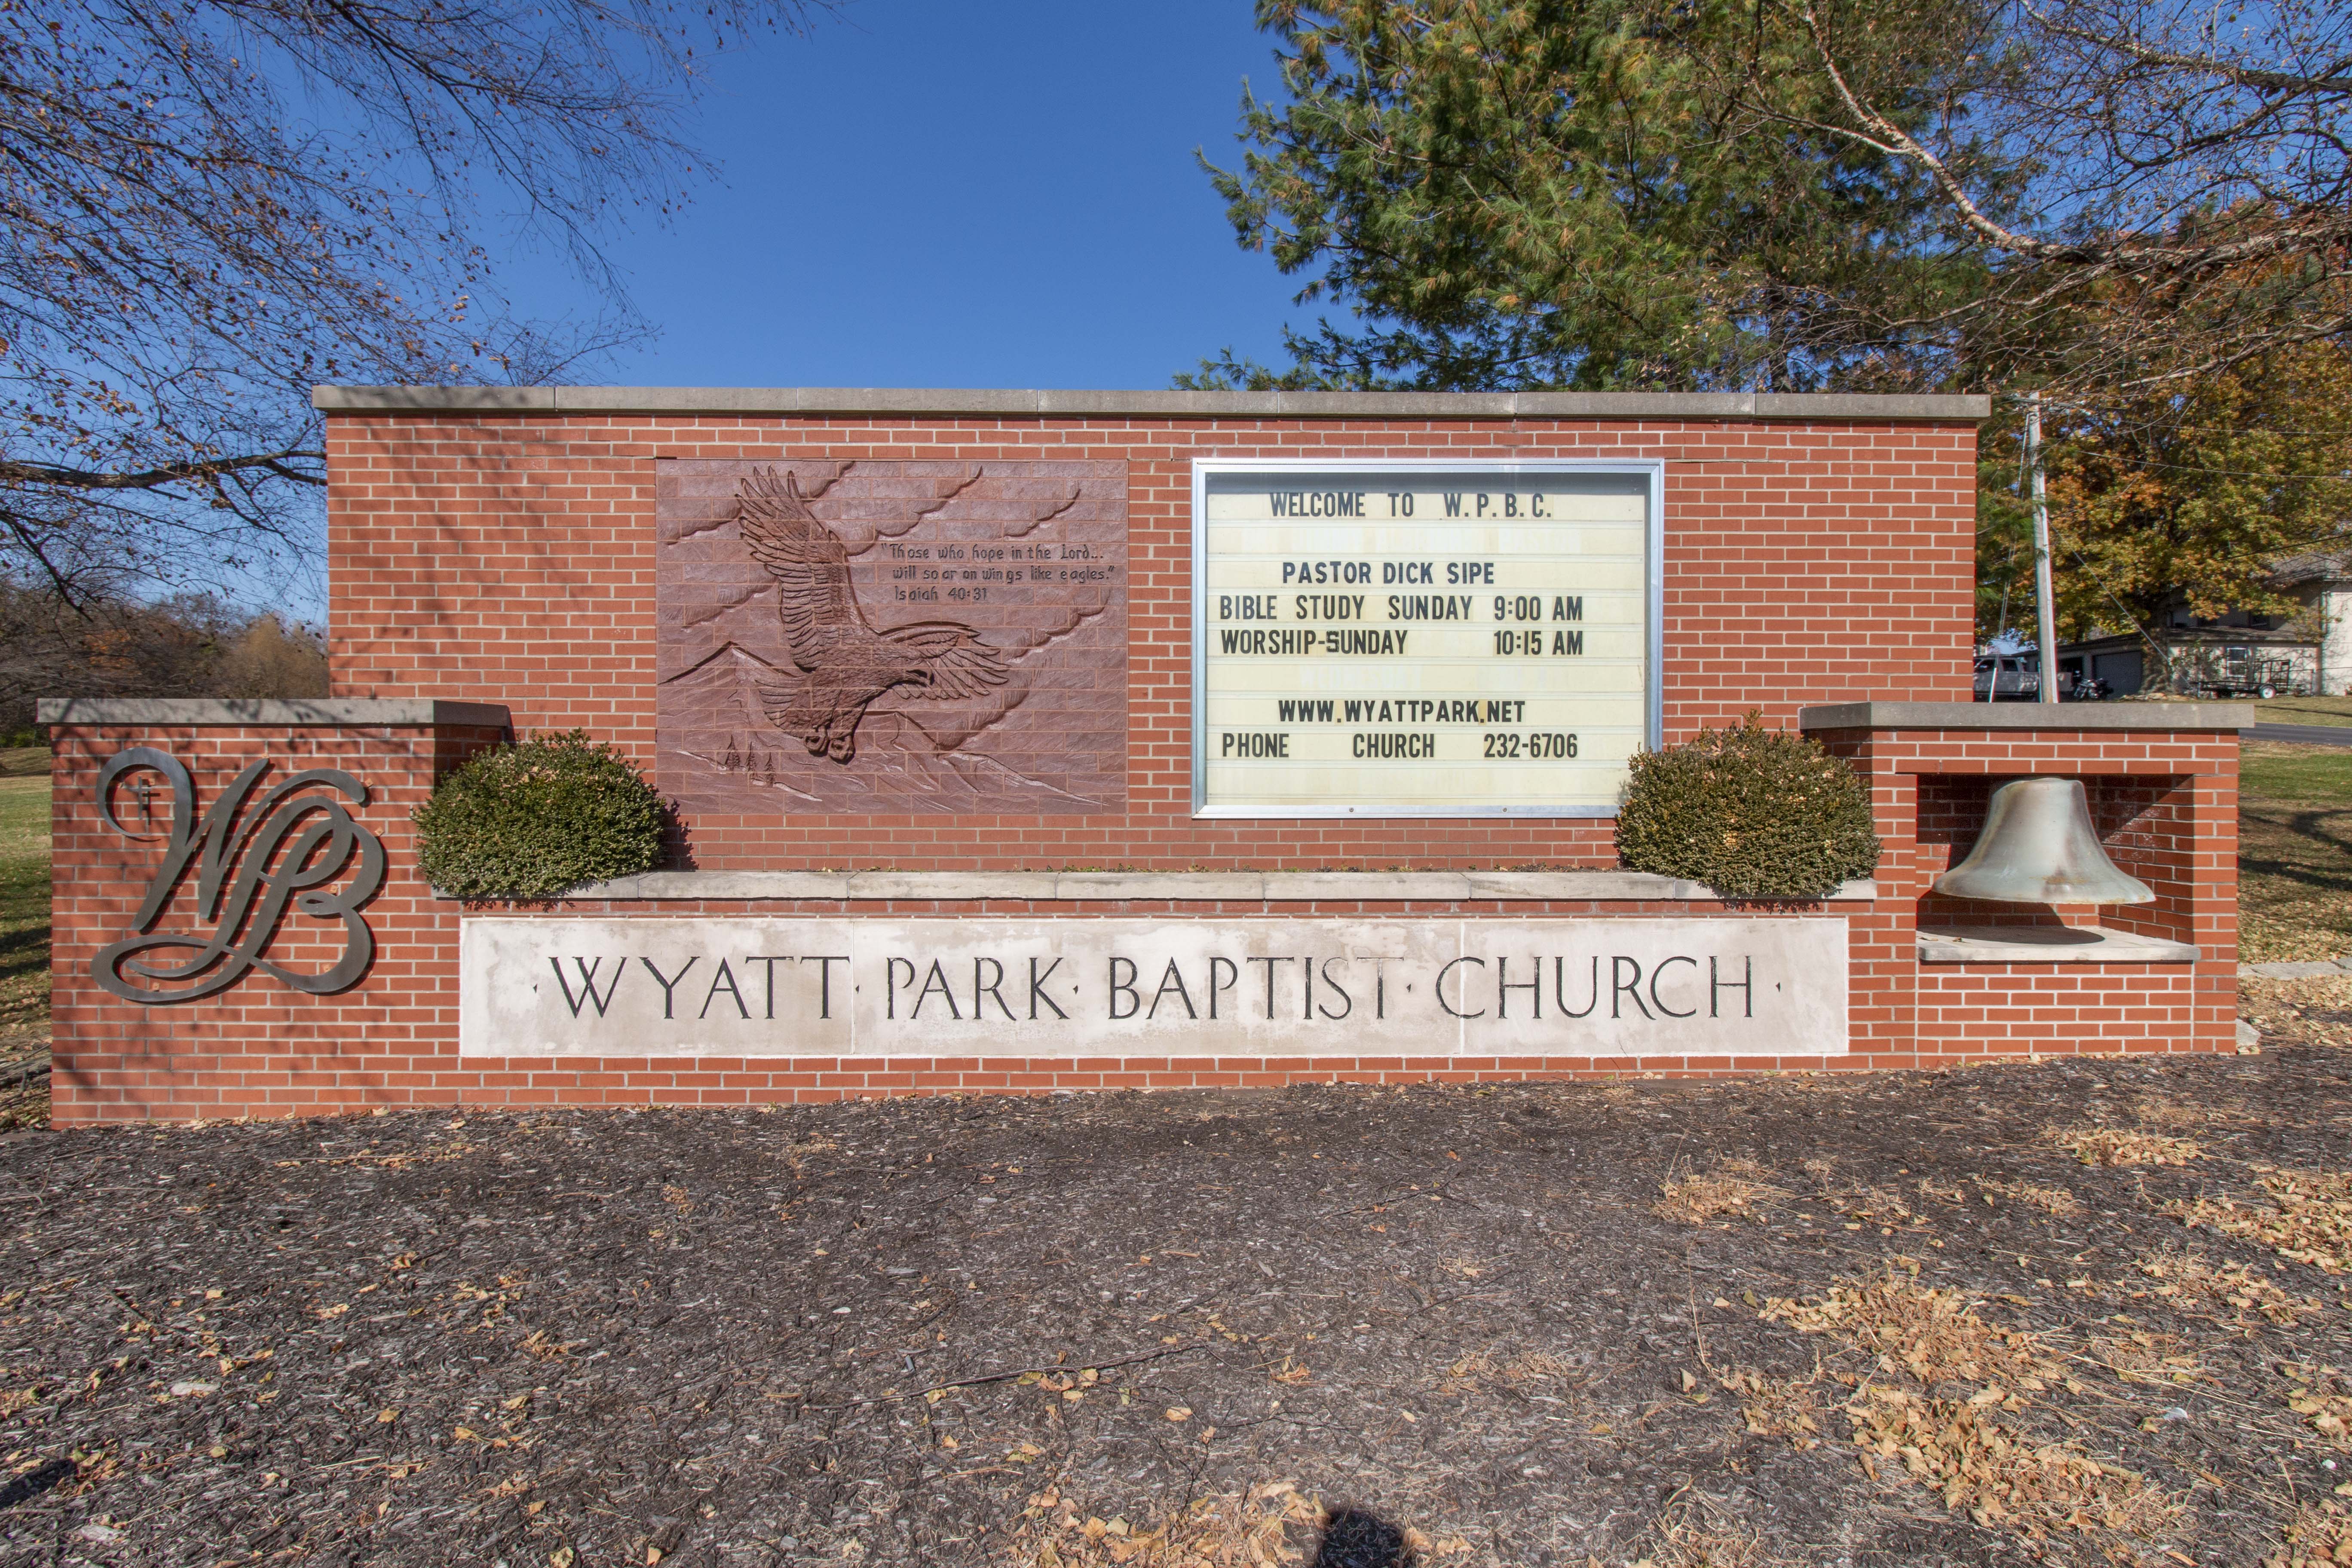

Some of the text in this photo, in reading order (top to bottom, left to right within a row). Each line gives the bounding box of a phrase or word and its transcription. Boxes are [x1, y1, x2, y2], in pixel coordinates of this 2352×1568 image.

[1270, 492, 1550, 517] WELCOME TO W.P.B.C.
[881, 544, 1104, 560] "Those who hope in the Lord...
[893, 566, 1116, 584] will soar on wings like eagles."
[1283, 562, 1493, 584] PASTOR DICK SIPE
[895, 586, 987, 600] Isaiah 40:31
[1221, 595, 1582, 620] BIBLE STUDY SUNDAY 9:00 AM
[1222, 630, 1582, 655] WORSHIP-SUNDAY 10:15 AM
[1279, 701, 1525, 723] WWW.WYATTPARK.NET
[1223, 733, 1577, 758] PHONE CHURCH 232-6706
[549, 956, 1752, 1020] WYATT PARK BAPTIST CHURCH
